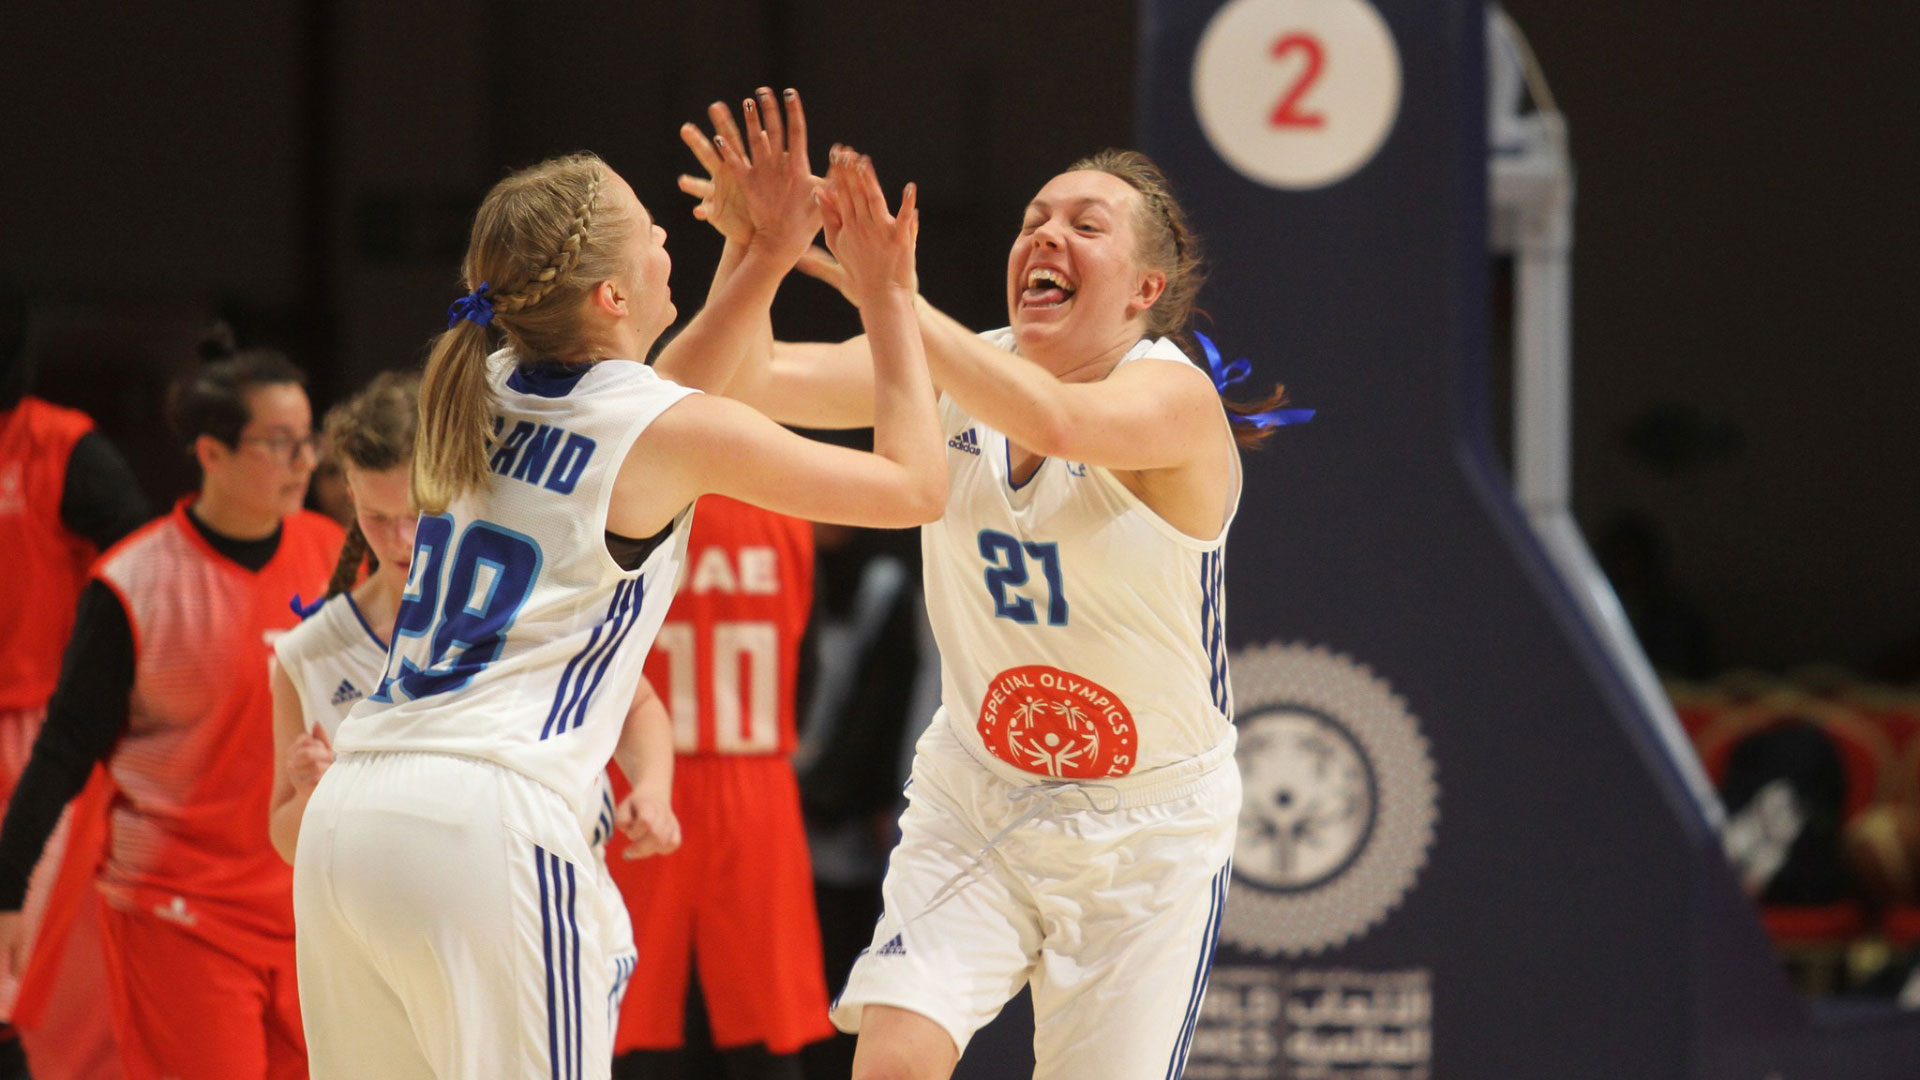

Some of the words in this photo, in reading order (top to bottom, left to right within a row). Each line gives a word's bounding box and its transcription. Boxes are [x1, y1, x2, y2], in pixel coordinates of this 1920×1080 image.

[1271, 32, 1326, 131] 2
[948, 439, 981, 456] adidas
[977, 528, 1069, 627] 21
[655, 620, 779, 756] 10
[984, 673, 1034, 726] SPECIAL
[1040, 673, 1129, 736] OLYMPICS
